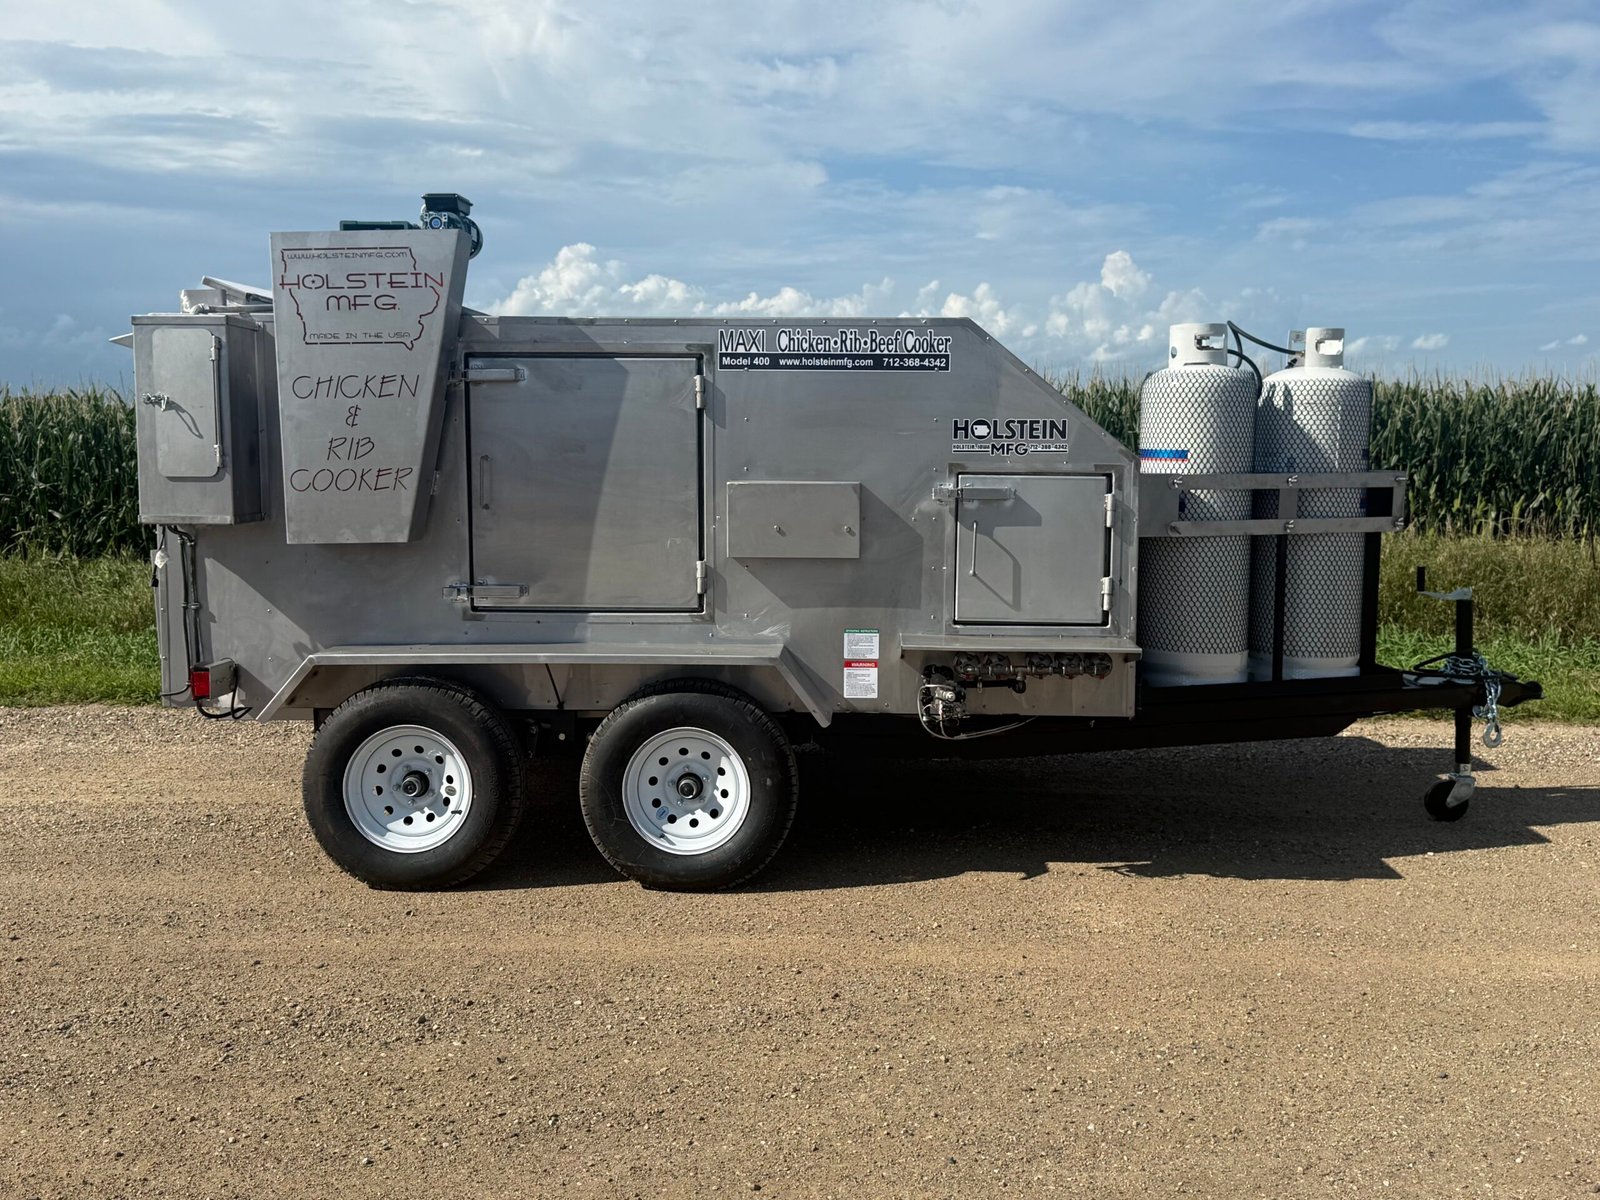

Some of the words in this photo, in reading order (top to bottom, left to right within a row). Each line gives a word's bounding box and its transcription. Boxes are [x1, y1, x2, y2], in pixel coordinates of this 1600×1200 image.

[287, 251, 408, 260] WWW.HOLSTEINMFG.COM
[279, 272, 444, 290] HOLSTEIN
[326, 294, 401, 311] MFG.
[309, 332, 341, 340] MADE
[345, 332, 358, 340] IN
[362, 331, 384, 339] THE
[387, 331, 411, 339] USA
[719, 329, 765, 352] MAXI
[903, 330, 951, 353] Cooker
[722, 356, 751, 366] Model
[753, 357, 770, 366] 400
[779, 357, 874, 369] www.holsteinmfg.com
[882, 358, 946, 367] 712-368-4342
[292, 374, 420, 399] CHICKEN
[345, 404, 362, 428] &
[952, 418, 1067, 440] HOLSTEIN
[327, 436, 375, 461] RIB
[990, 442, 1028, 455] MFG
[290, 467, 413, 492] COOKER
